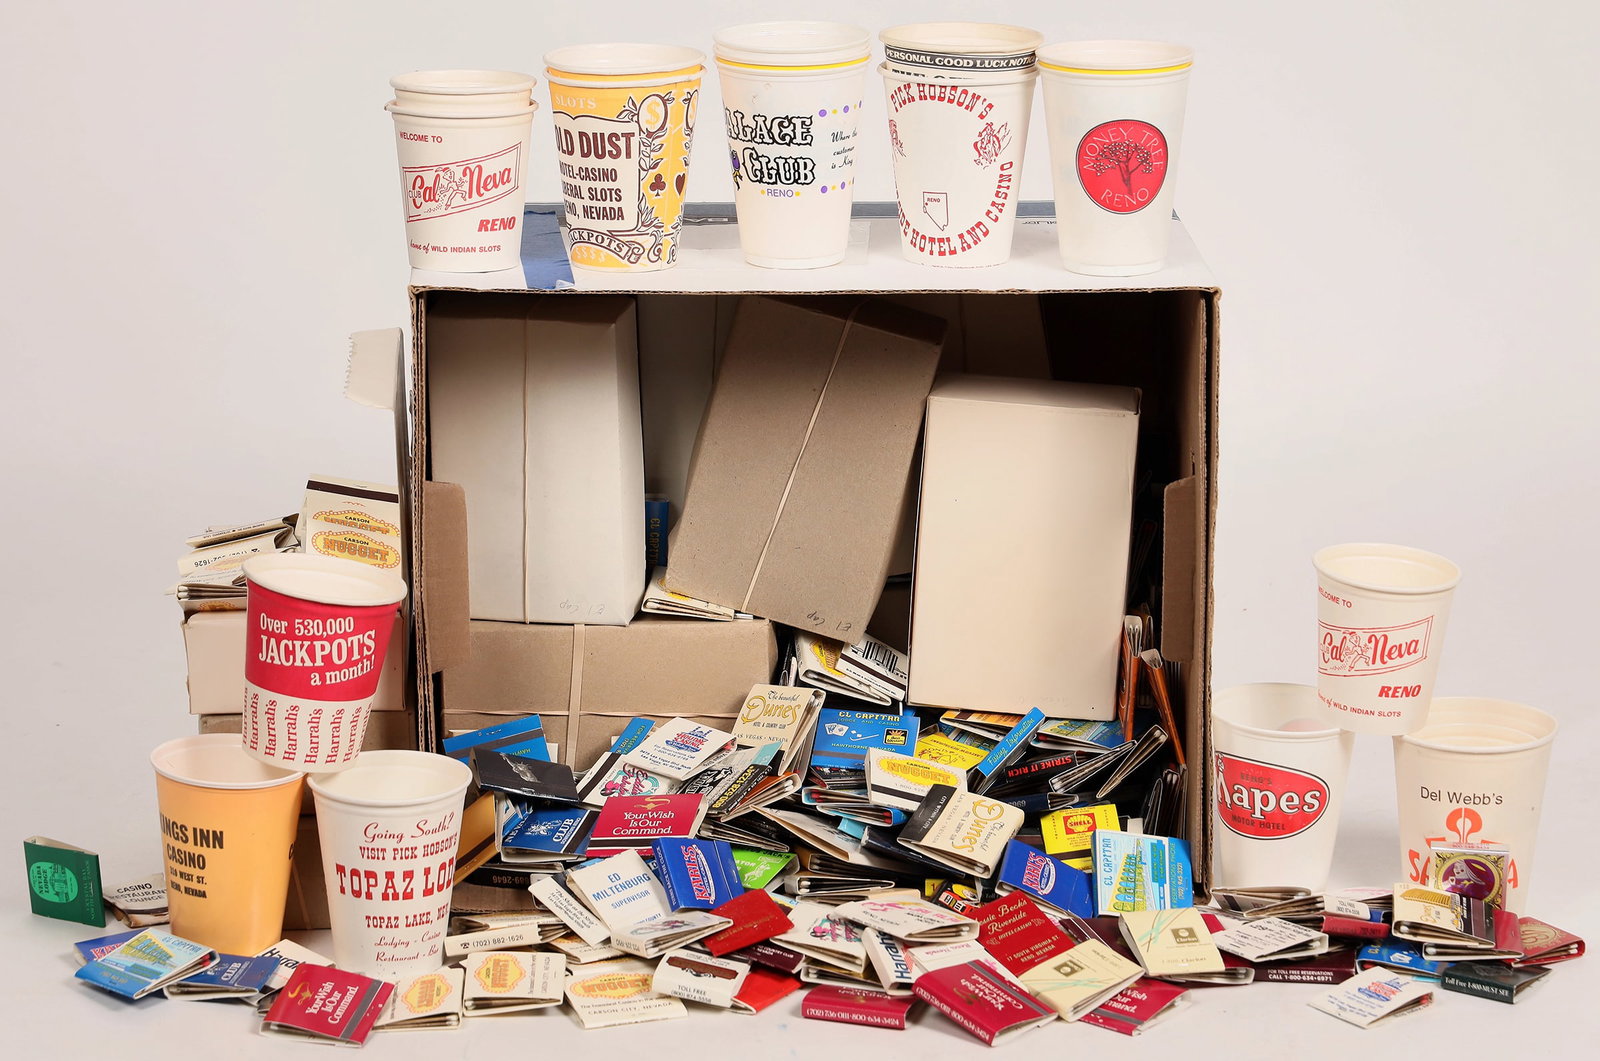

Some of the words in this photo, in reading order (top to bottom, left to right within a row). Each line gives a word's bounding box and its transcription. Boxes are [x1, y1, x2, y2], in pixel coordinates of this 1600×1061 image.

[886, 48, 933, 65] PERSONAL
[934, 56, 974, 68] GOOD
[976, 58, 1008, 68] LUCK
[554, 94, 597, 110] SLOTS
[889, 83, 916, 113] PICK
[916, 83, 994, 120] HOBSON'S
[399, 130, 429, 143] WELCOME
[430, 134, 443, 144] TO
[579, 130, 636, 160] DUST
[1083, 126, 1134, 172] MONEY
[1140, 129, 1164, 171] TREE
[742, 147, 816, 186] CLUB
[411, 170, 441, 210] Cal
[462, 164, 513, 200] Neva
[408, 190, 422, 201] CLUB
[588, 185, 622, 203] SLOTS
[766, 188, 794, 198] RENO
[1100, 187, 1149, 208] RENO
[582, 204, 625, 221] NEVADA
[910, 228, 958, 257] HOTEL
[958, 220, 990, 252] AND
[985, 160, 1014, 224] CASINO
[477, 215, 517, 233] RENO
[422, 242, 430, 255] of
[431, 245, 449, 254] WILD
[450, 245, 477, 254] INDIAN
[478, 244, 502, 253] SLOTS
[344, 515, 370, 524] CARSON
[323, 537, 389, 563] NUGGET
[343, 536, 369, 546] CARSON
[1341, 599, 1353, 609] TO
[260, 612, 288, 635] Over
[294, 616, 355, 638] 530,000
[258, 629, 376, 668] JACKPOTS
[1322, 630, 1347, 664] Cal
[1367, 633, 1420, 666] Neva
[310, 671, 322, 686] a
[325, 654, 376, 685] month!
[767, 690, 777, 700] The
[777, 692, 799, 702] beautiful
[1377, 684, 1422, 699] RENO
[741, 695, 802, 726] Dunes
[855, 712, 901, 723] CAPITAN
[1332, 700, 1348, 712] WILD
[1349, 706, 1376, 717] INDIAN
[1377, 710, 1402, 718] SLOTS
[264, 699, 278, 758] Harrah's
[283, 704, 300, 762] Harrah's
[304, 707, 324, 765] Harrah's
[325, 707, 346, 765] Harrah's
[886, 760, 951, 784] NUGGET
[906, 761, 931, 770] CARSON
[1008, 766, 1028, 778] RICH
[1040, 755, 1072, 770] STRIKE
[1420, 786, 1441, 802] Del
[1447, 791, 1504, 806] Webb's
[624, 811, 648, 820] Your
[648, 810, 675, 819] Wish
[640, 818, 662, 827] Our
[1069, 819, 1092, 827] SHELL
[1231, 814, 1256, 828] MOTOR
[1259, 820, 1286, 831] HOTEL
[363, 822, 405, 844] Going
[410, 812, 455, 839] South?
[552, 818, 575, 843] CLUB
[612, 826, 673, 836] Command.
[952, 799, 1004, 852] Dunes
[193, 827, 225, 850] INN
[359, 846, 387, 861] VISIT
[392, 846, 418, 861] PICK
[422, 832, 459, 858] HOBSON'S
[166, 844, 207, 870] CASINO
[656, 846, 666, 866] CLOCK
[1101, 838, 1113, 874] CAPITAN
[179, 869, 195, 883] WEST
[196, 874, 208, 886] ST.
[607, 872, 621, 884] ED
[680, 845, 711, 902] KARL'S
[1022, 851, 1047, 891] KARL'S
[116, 882, 153, 895] CASINO
[335, 863, 415, 902] TOPAZ
[591, 873, 652, 902] MILTENBURG
[1104, 876, 1113, 887] EL
[124, 894, 165, 904] LOUNGE
[184, 885, 208, 899] NEVADA
[610, 890, 651, 910] SUPERVISOR
[998, 897, 1028, 918] Beck's
[365, 915, 401, 929] TOPAZ
[405, 911, 434, 928] LAKE,
[988, 911, 1028, 935] Riverside
[472, 939, 492, 948] (702)
[492, 934, 524, 945] 882-1626
[998, 929, 1014, 940] HOTEL
[1013, 922, 1033, 936] CASINO
[374, 935, 410, 948] Lodging
[764, 946, 783, 956] COUNTRY
[1013, 948, 1030, 960] SOUTH
[1030, 938, 1053, 953] VIRGINIA
[1036, 944, 1056, 958] NEVADA
[261, 947, 307, 971] Harra
[375, 951, 420, 963] Restaurant
[220, 962, 242, 982] CLUB
[692, 988, 708, 996] FREE
[1444, 976, 1458, 986] Toll
[1457, 978, 1468, 988] Free
[1498, 988, 1510, 996] SEE
[304, 999, 324, 1014] Your
[314, 981, 335, 1000] Wish
[326, 990, 342, 1006] Our
[328, 986, 360, 1024] Command.
